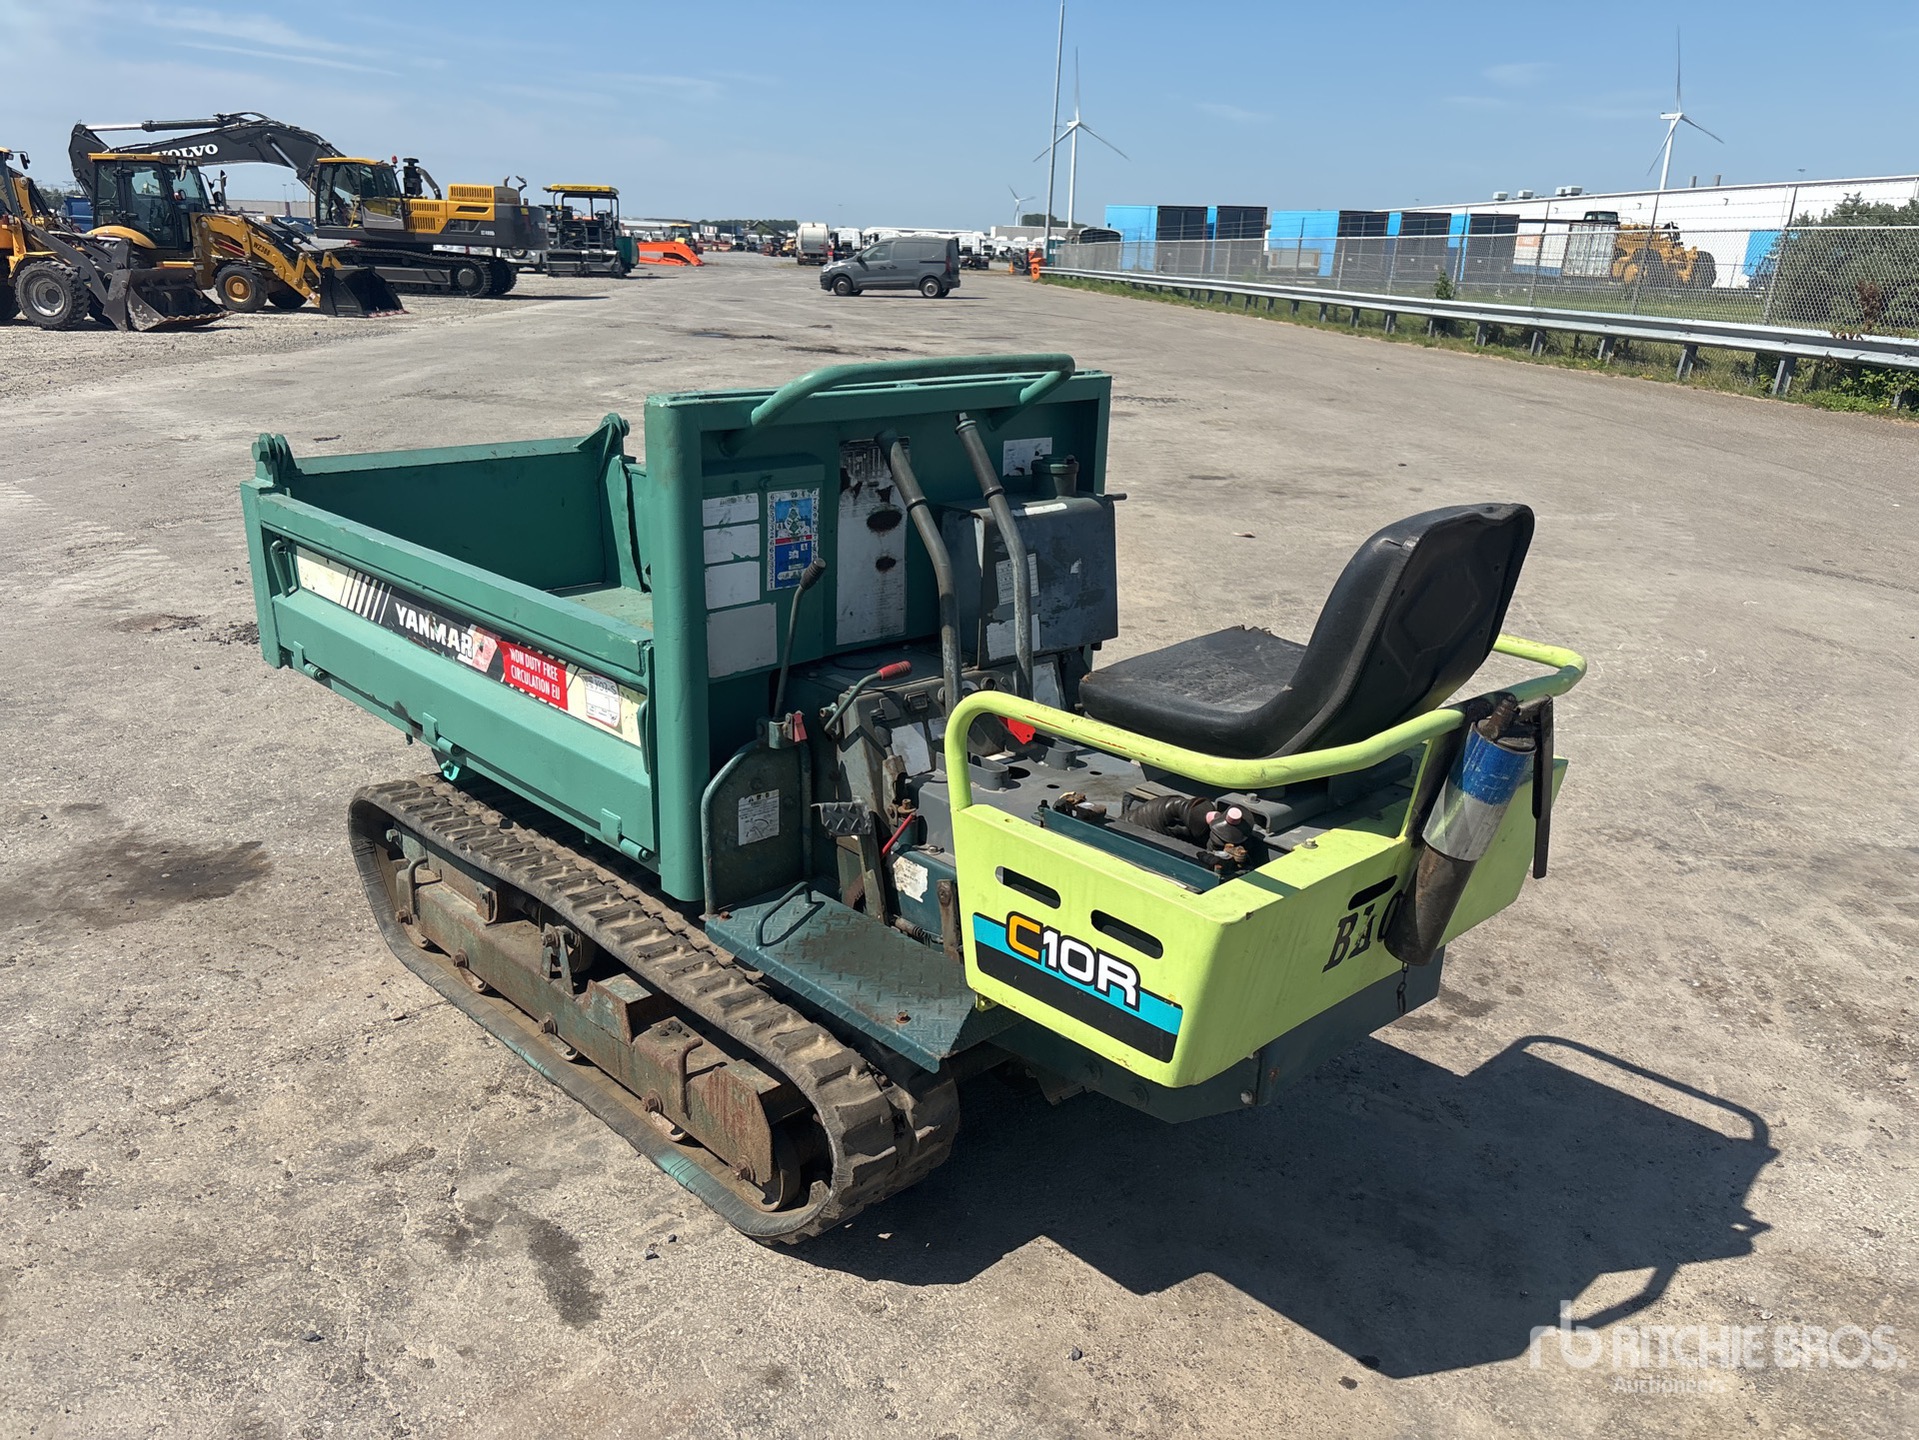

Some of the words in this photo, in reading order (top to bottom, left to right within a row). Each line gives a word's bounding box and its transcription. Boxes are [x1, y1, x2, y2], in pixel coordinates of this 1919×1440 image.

[394, 602, 474, 660] YANMAR
[509, 647, 525, 667] NON
[525, 653, 542, 674] DUTY
[543, 660, 559, 682] FREE
[511, 664, 550, 696] CIRCULATION
[551, 683, 561, 700] EU
[1008, 914, 1139, 1008] C10R
